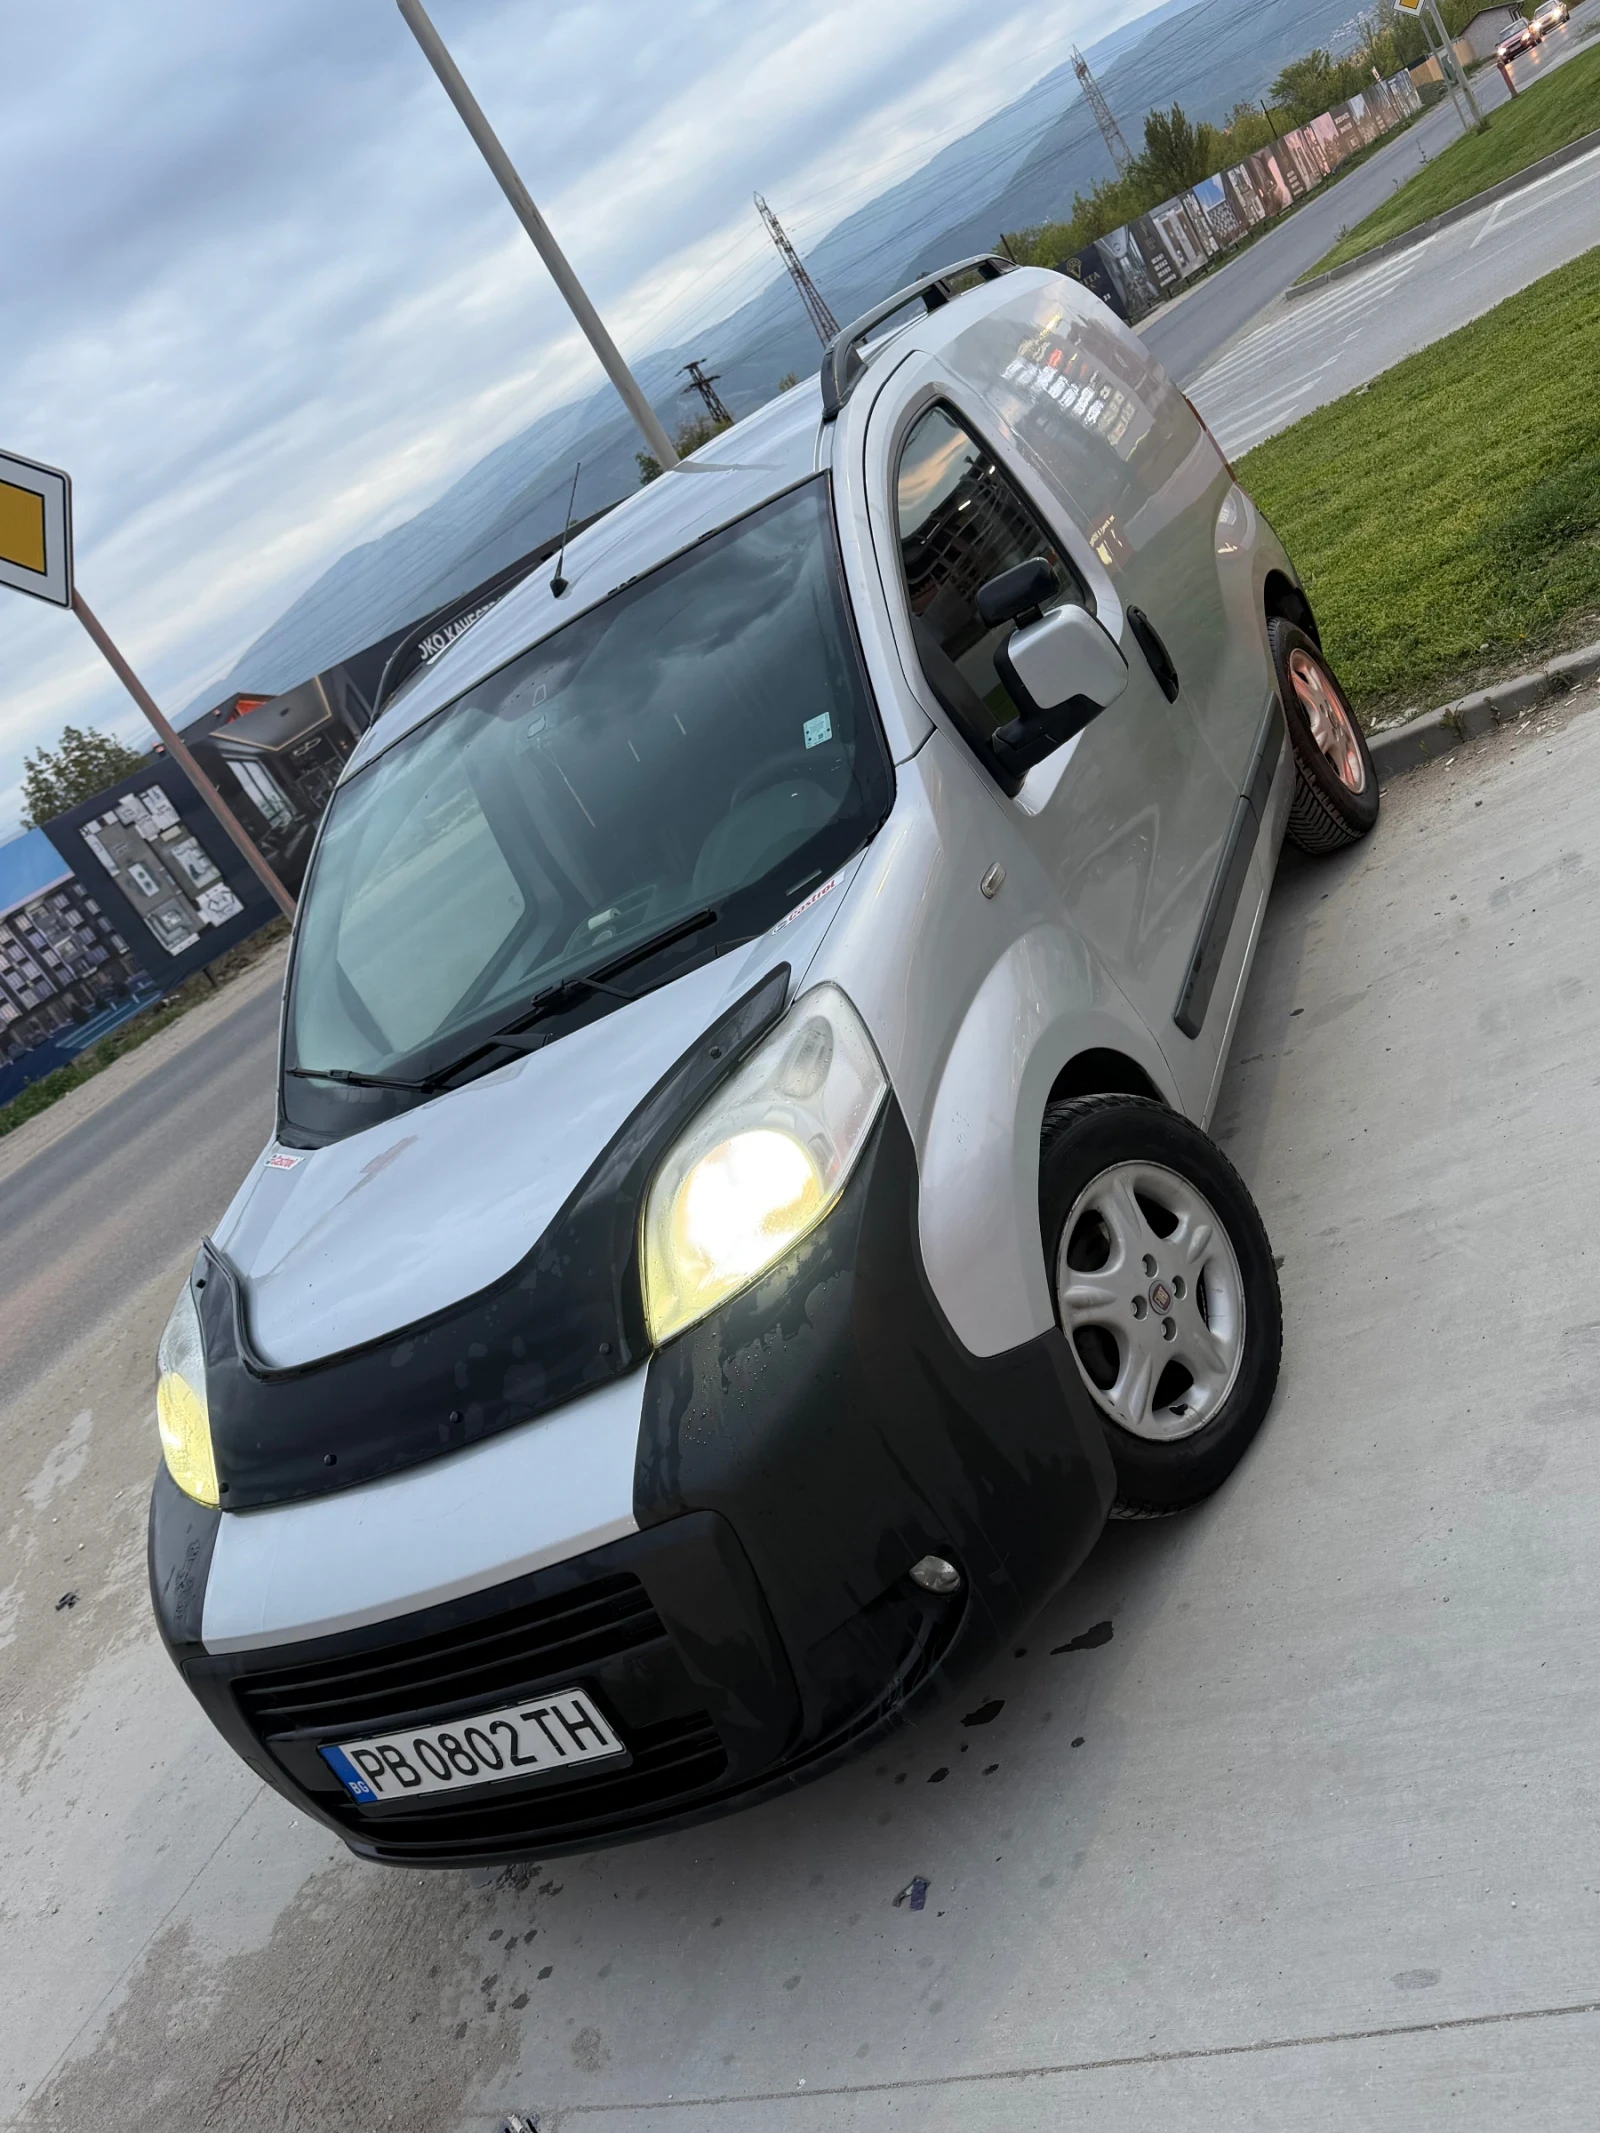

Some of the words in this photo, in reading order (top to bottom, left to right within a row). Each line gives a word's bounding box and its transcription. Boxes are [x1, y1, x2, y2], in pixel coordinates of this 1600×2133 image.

[788, 880, 836, 921] Castrol
[350, 1744, 422, 1792] PB
[413, 1720, 538, 1781] 0802
[519, 1699, 609, 1756] TH
[348, 1780, 370, 1795] BG
